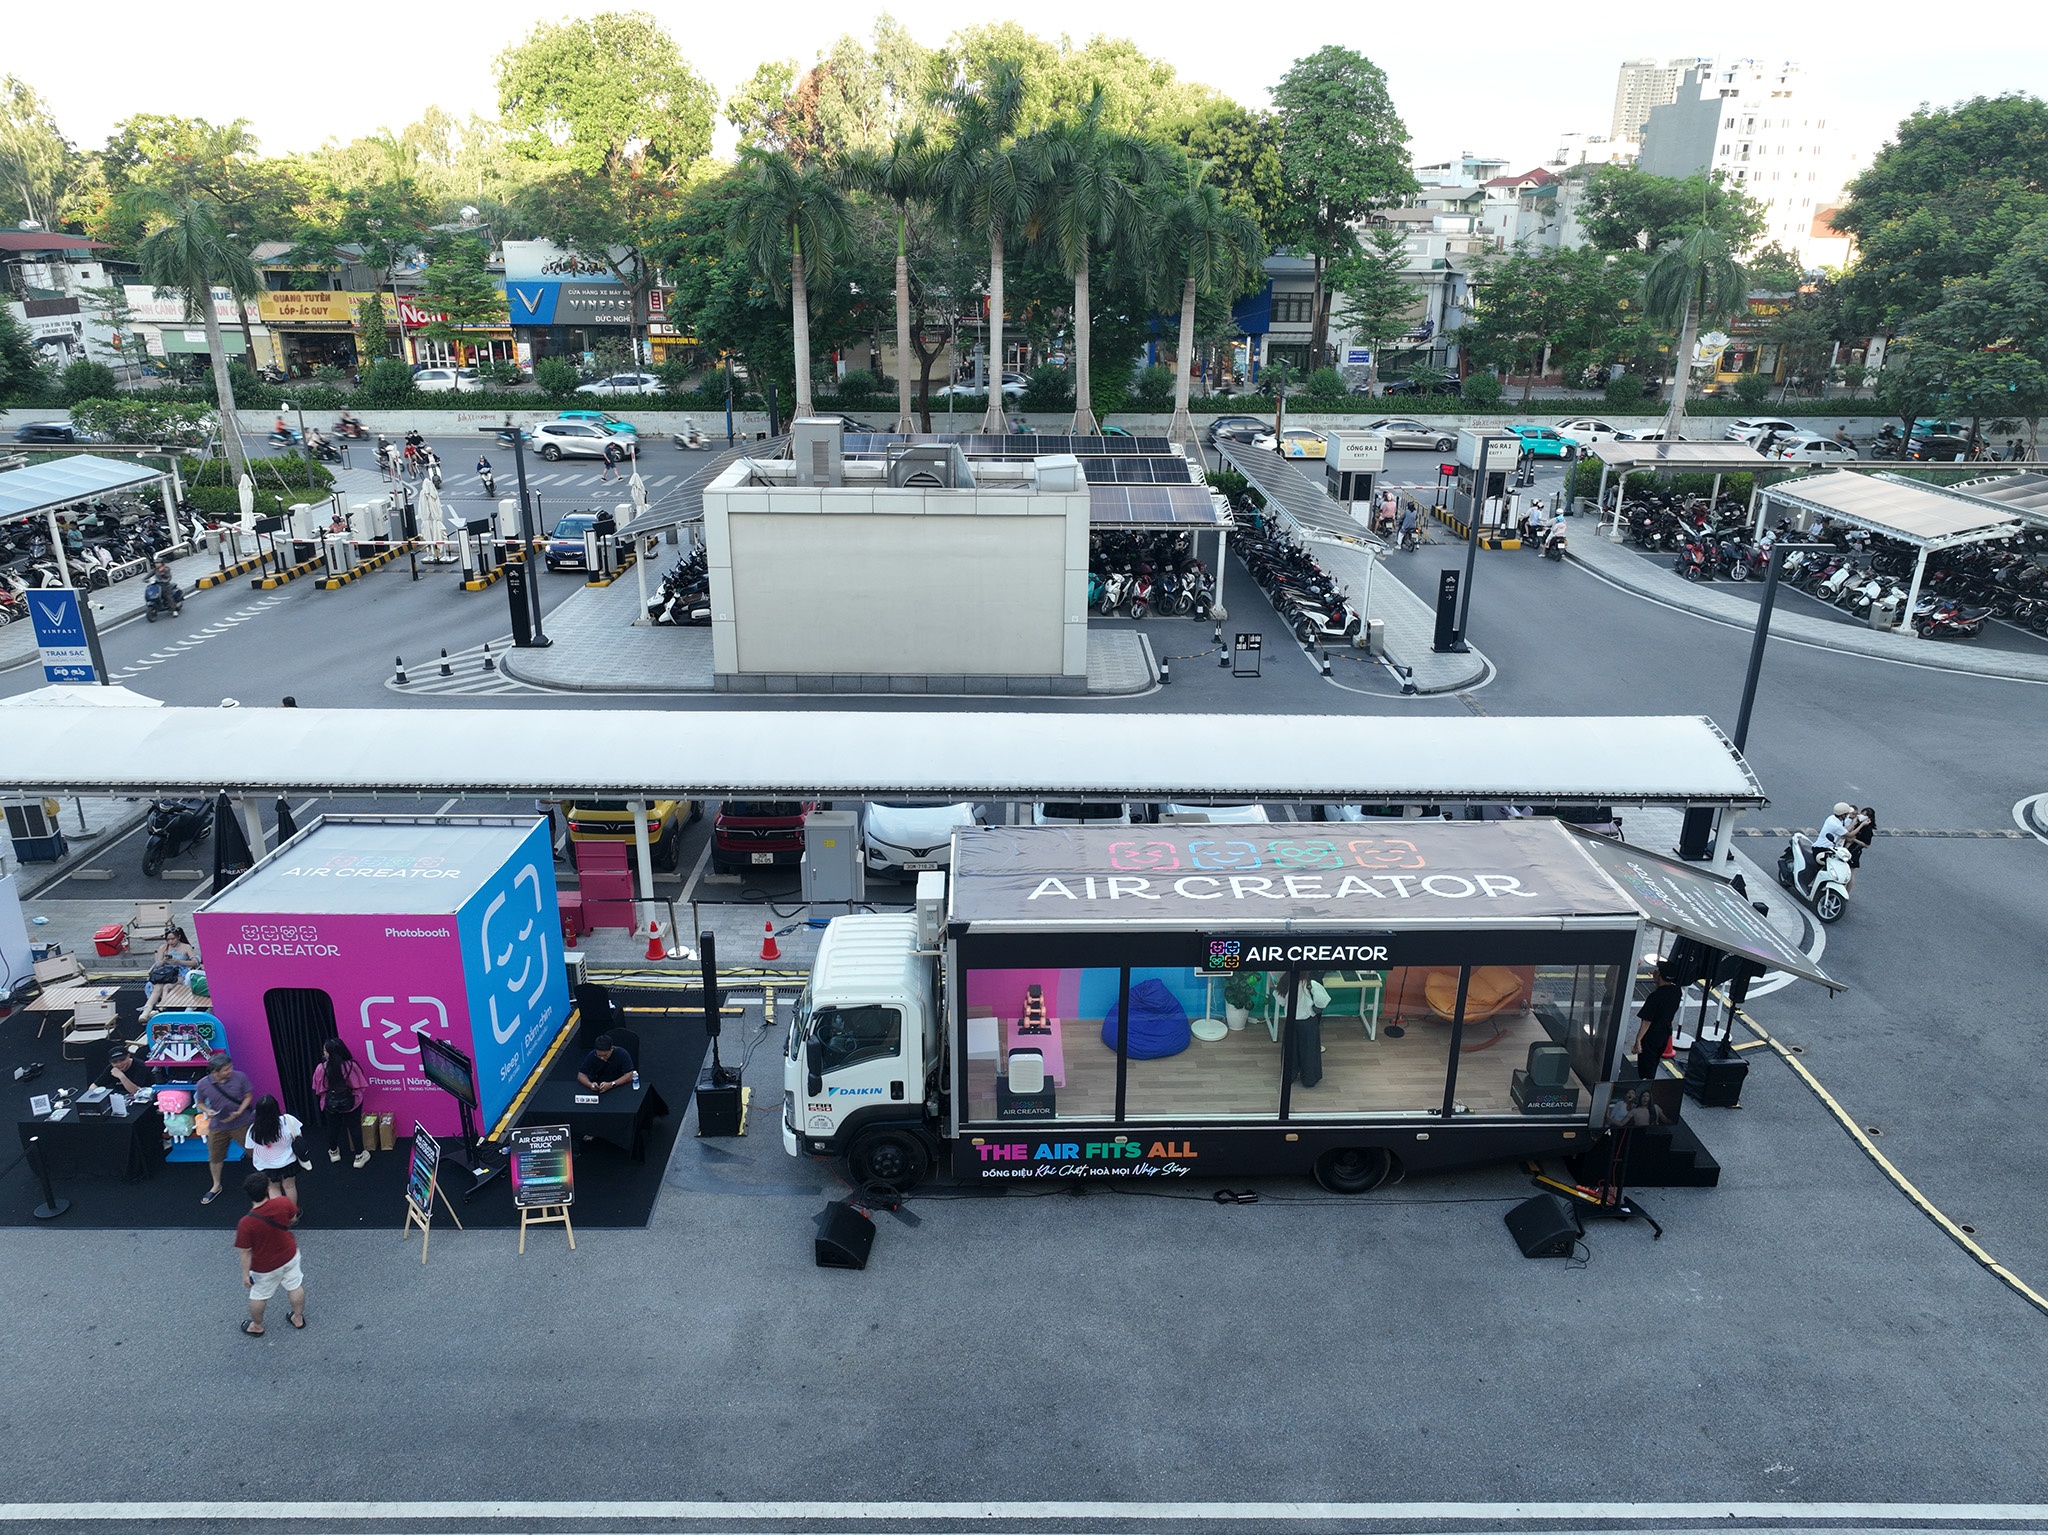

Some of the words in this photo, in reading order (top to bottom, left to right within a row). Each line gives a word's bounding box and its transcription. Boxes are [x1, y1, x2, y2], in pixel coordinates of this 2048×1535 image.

[273, 294, 302, 302] QUANG
[312, 307, 328, 315] QUY
[281, 868, 330, 876] AIR
[335, 868, 462, 878] CREATOR
[1026, 876, 1162, 901] AIR
[1173, 874, 1538, 900] CREATOR
[1626, 861, 1676, 910] CREATOR
[384, 928, 450, 938] Photobooth
[226, 944, 256, 956] AIR
[258, 944, 341, 956] CREATOR
[1246, 946, 1284, 962] AIR
[1286, 946, 1388, 962] CREATOR
[500, 1052, 520, 1082] Sleep
[406, 1078, 432, 1086] Năng
[840, 1088, 882, 1096] DAIKIN
[976, 1144, 1028, 1160] THE
[1034, 1143, 1080, 1160] AIR
[1086, 1142, 1142, 1158] FITS
[1147, 1142, 1198, 1158] ALL
[982, 1167, 1010, 1177] ĐỒNG
[1011, 1168, 1033, 1179] ĐIỆU
[1090, 1166, 1110, 1176] HOÀ
[1112, 1168, 1130, 1176] MỌI
